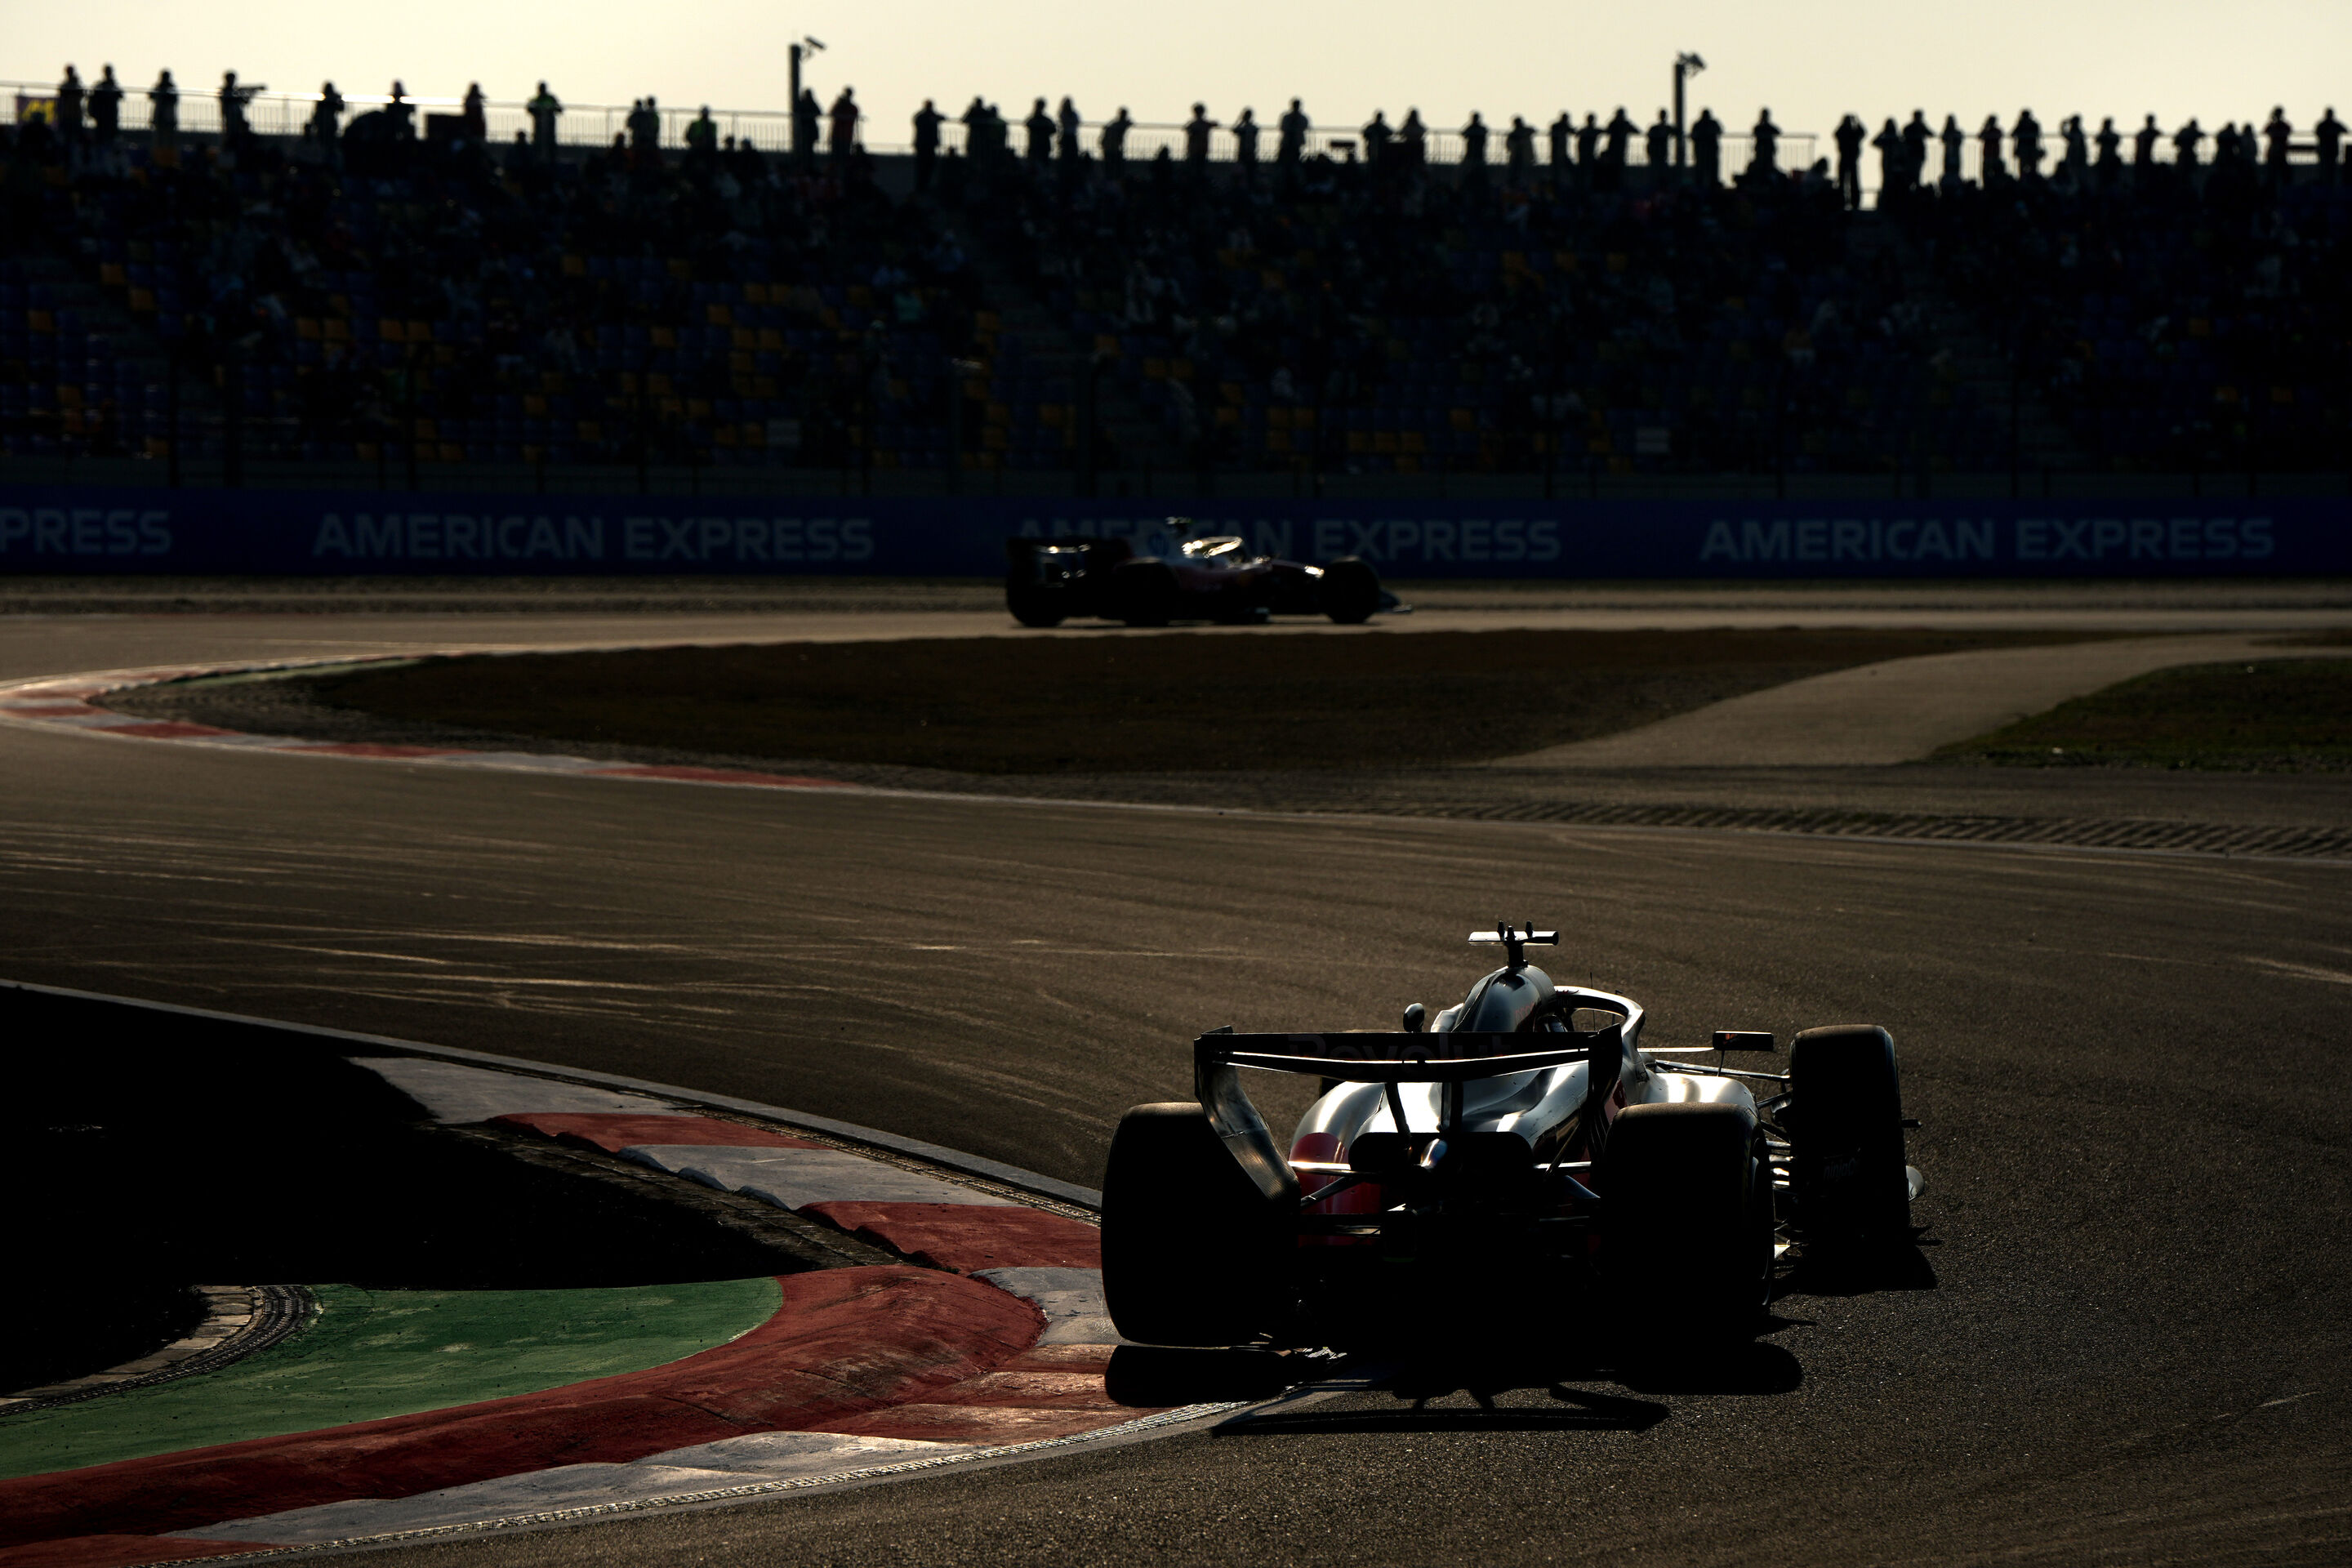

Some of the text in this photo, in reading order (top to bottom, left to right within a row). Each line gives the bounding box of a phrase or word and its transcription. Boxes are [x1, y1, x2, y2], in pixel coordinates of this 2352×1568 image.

[313, 513, 875, 561] AMERICAN EXPRESS
[1313, 519, 1563, 561] EXPRESS
[1699, 518, 2275, 561] AMERICAN EXPRESS
